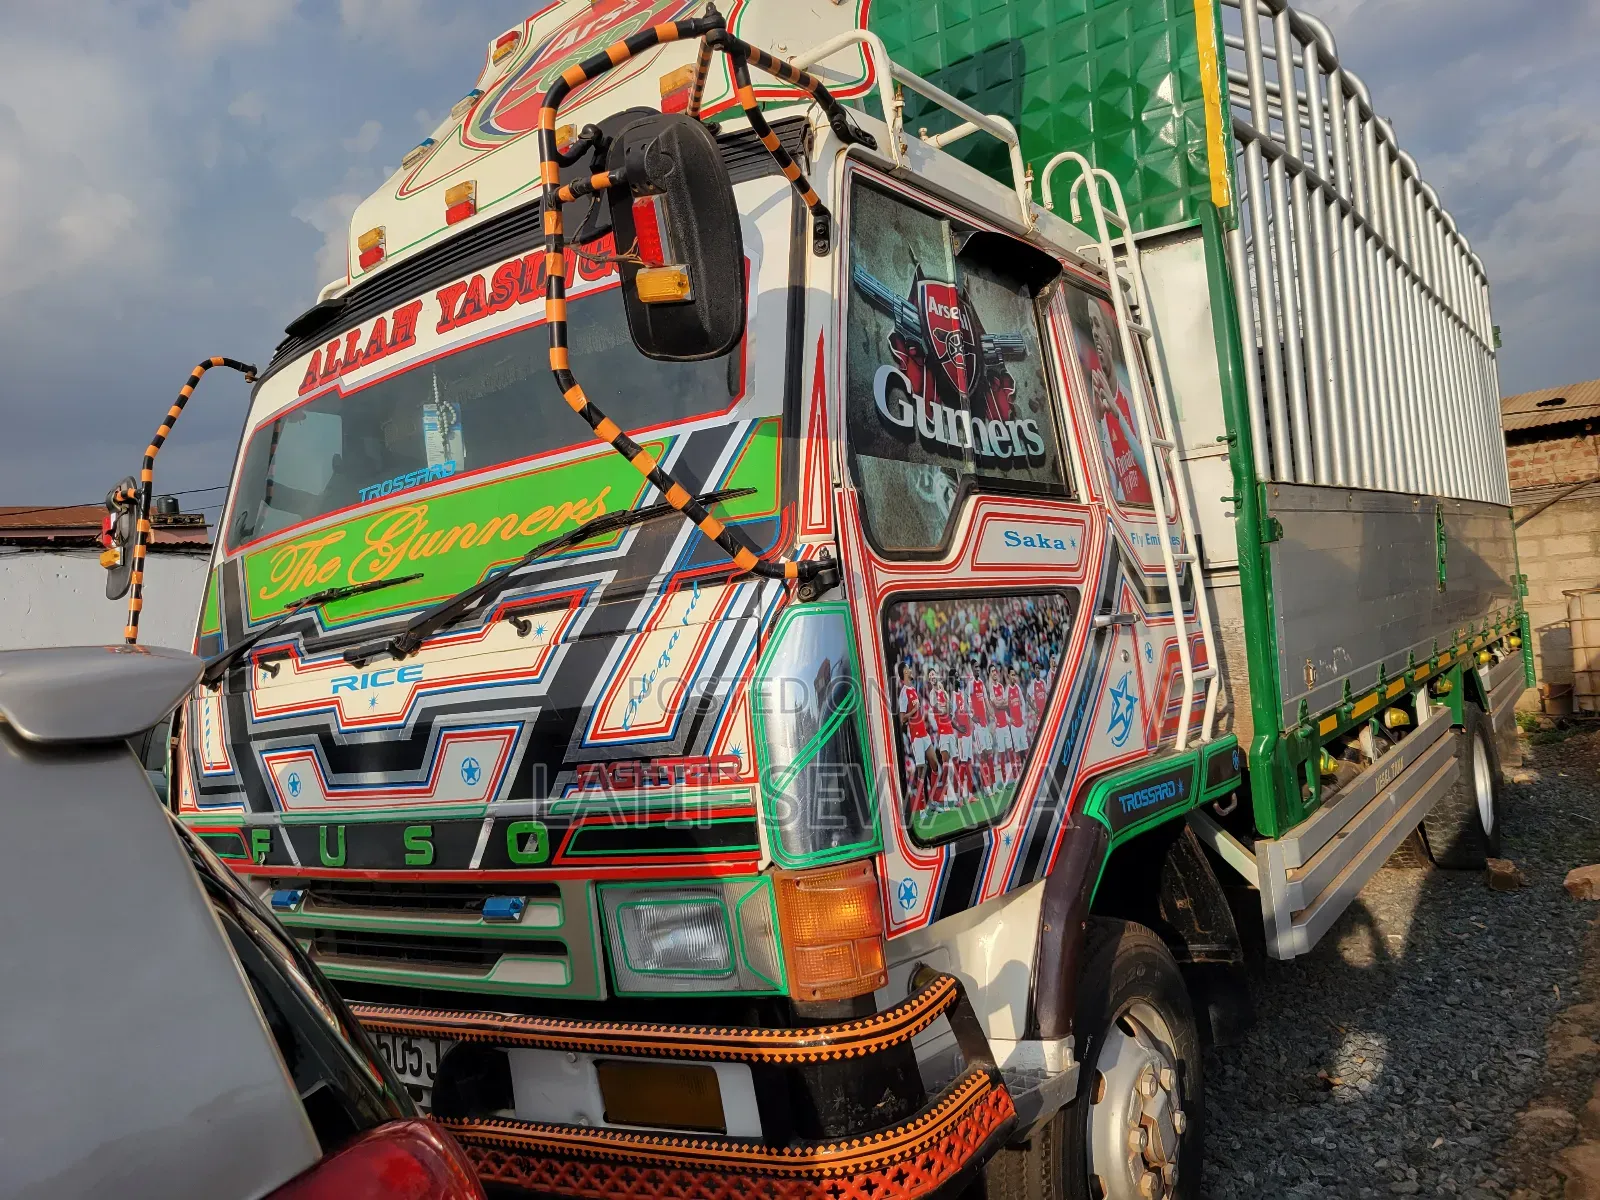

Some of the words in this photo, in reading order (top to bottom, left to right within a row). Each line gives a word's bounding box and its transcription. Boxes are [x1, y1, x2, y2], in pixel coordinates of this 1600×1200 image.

[298, 299, 422, 396] ALLAH
[873, 364, 1045, 458] Gunners
[359, 460, 456, 502] TROSSARD
[260, 530, 347, 600] The
[347, 486, 612, 585] Gunners
[1004, 530, 1066, 550] Saka
[1130, 532, 1144, 547] Fly
[1145, 533, 1181, 546] Emies
[330, 663, 424, 694] RICE
[577, 754, 745, 791] FIGHTER
[1118, 780, 1176, 814] TROSSARD
[252, 821, 550, 867] FUSO
